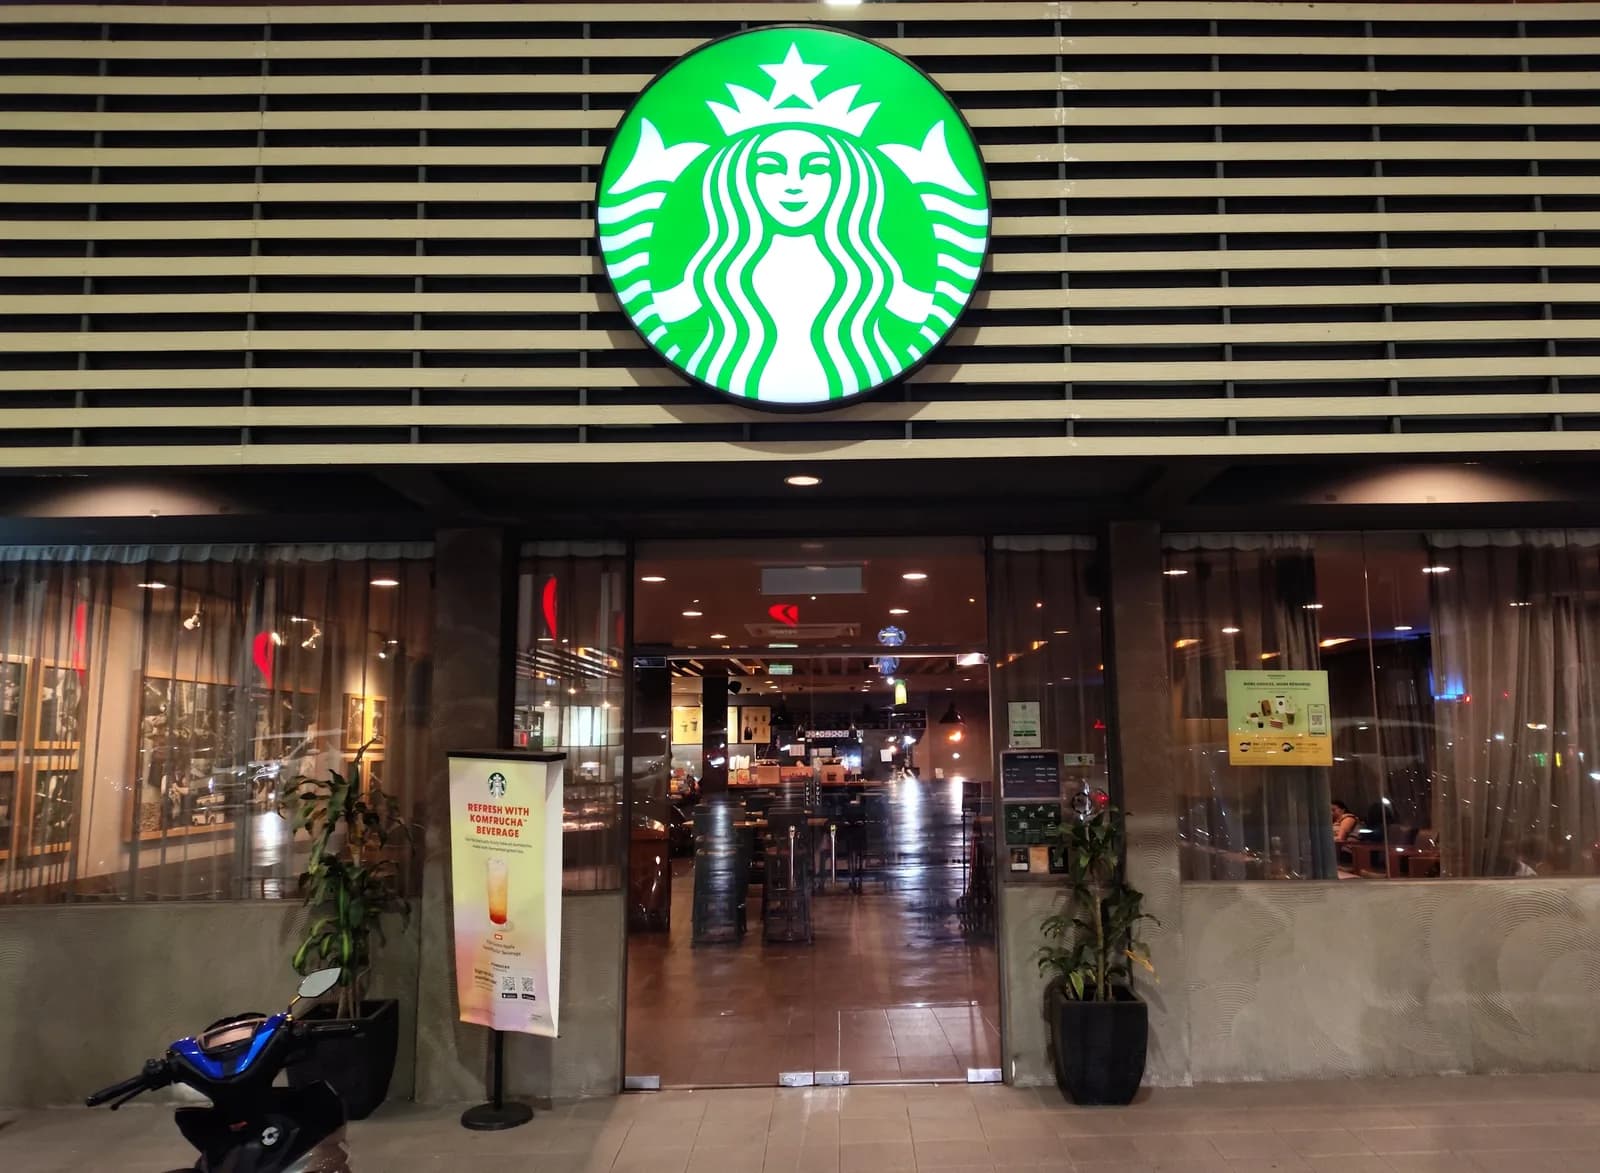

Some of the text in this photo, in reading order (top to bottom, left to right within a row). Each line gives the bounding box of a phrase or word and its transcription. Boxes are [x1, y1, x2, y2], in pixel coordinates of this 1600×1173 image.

[467, 803, 530, 816] REFRESH WITH
[476, 825, 520, 838] BEVERAGE
